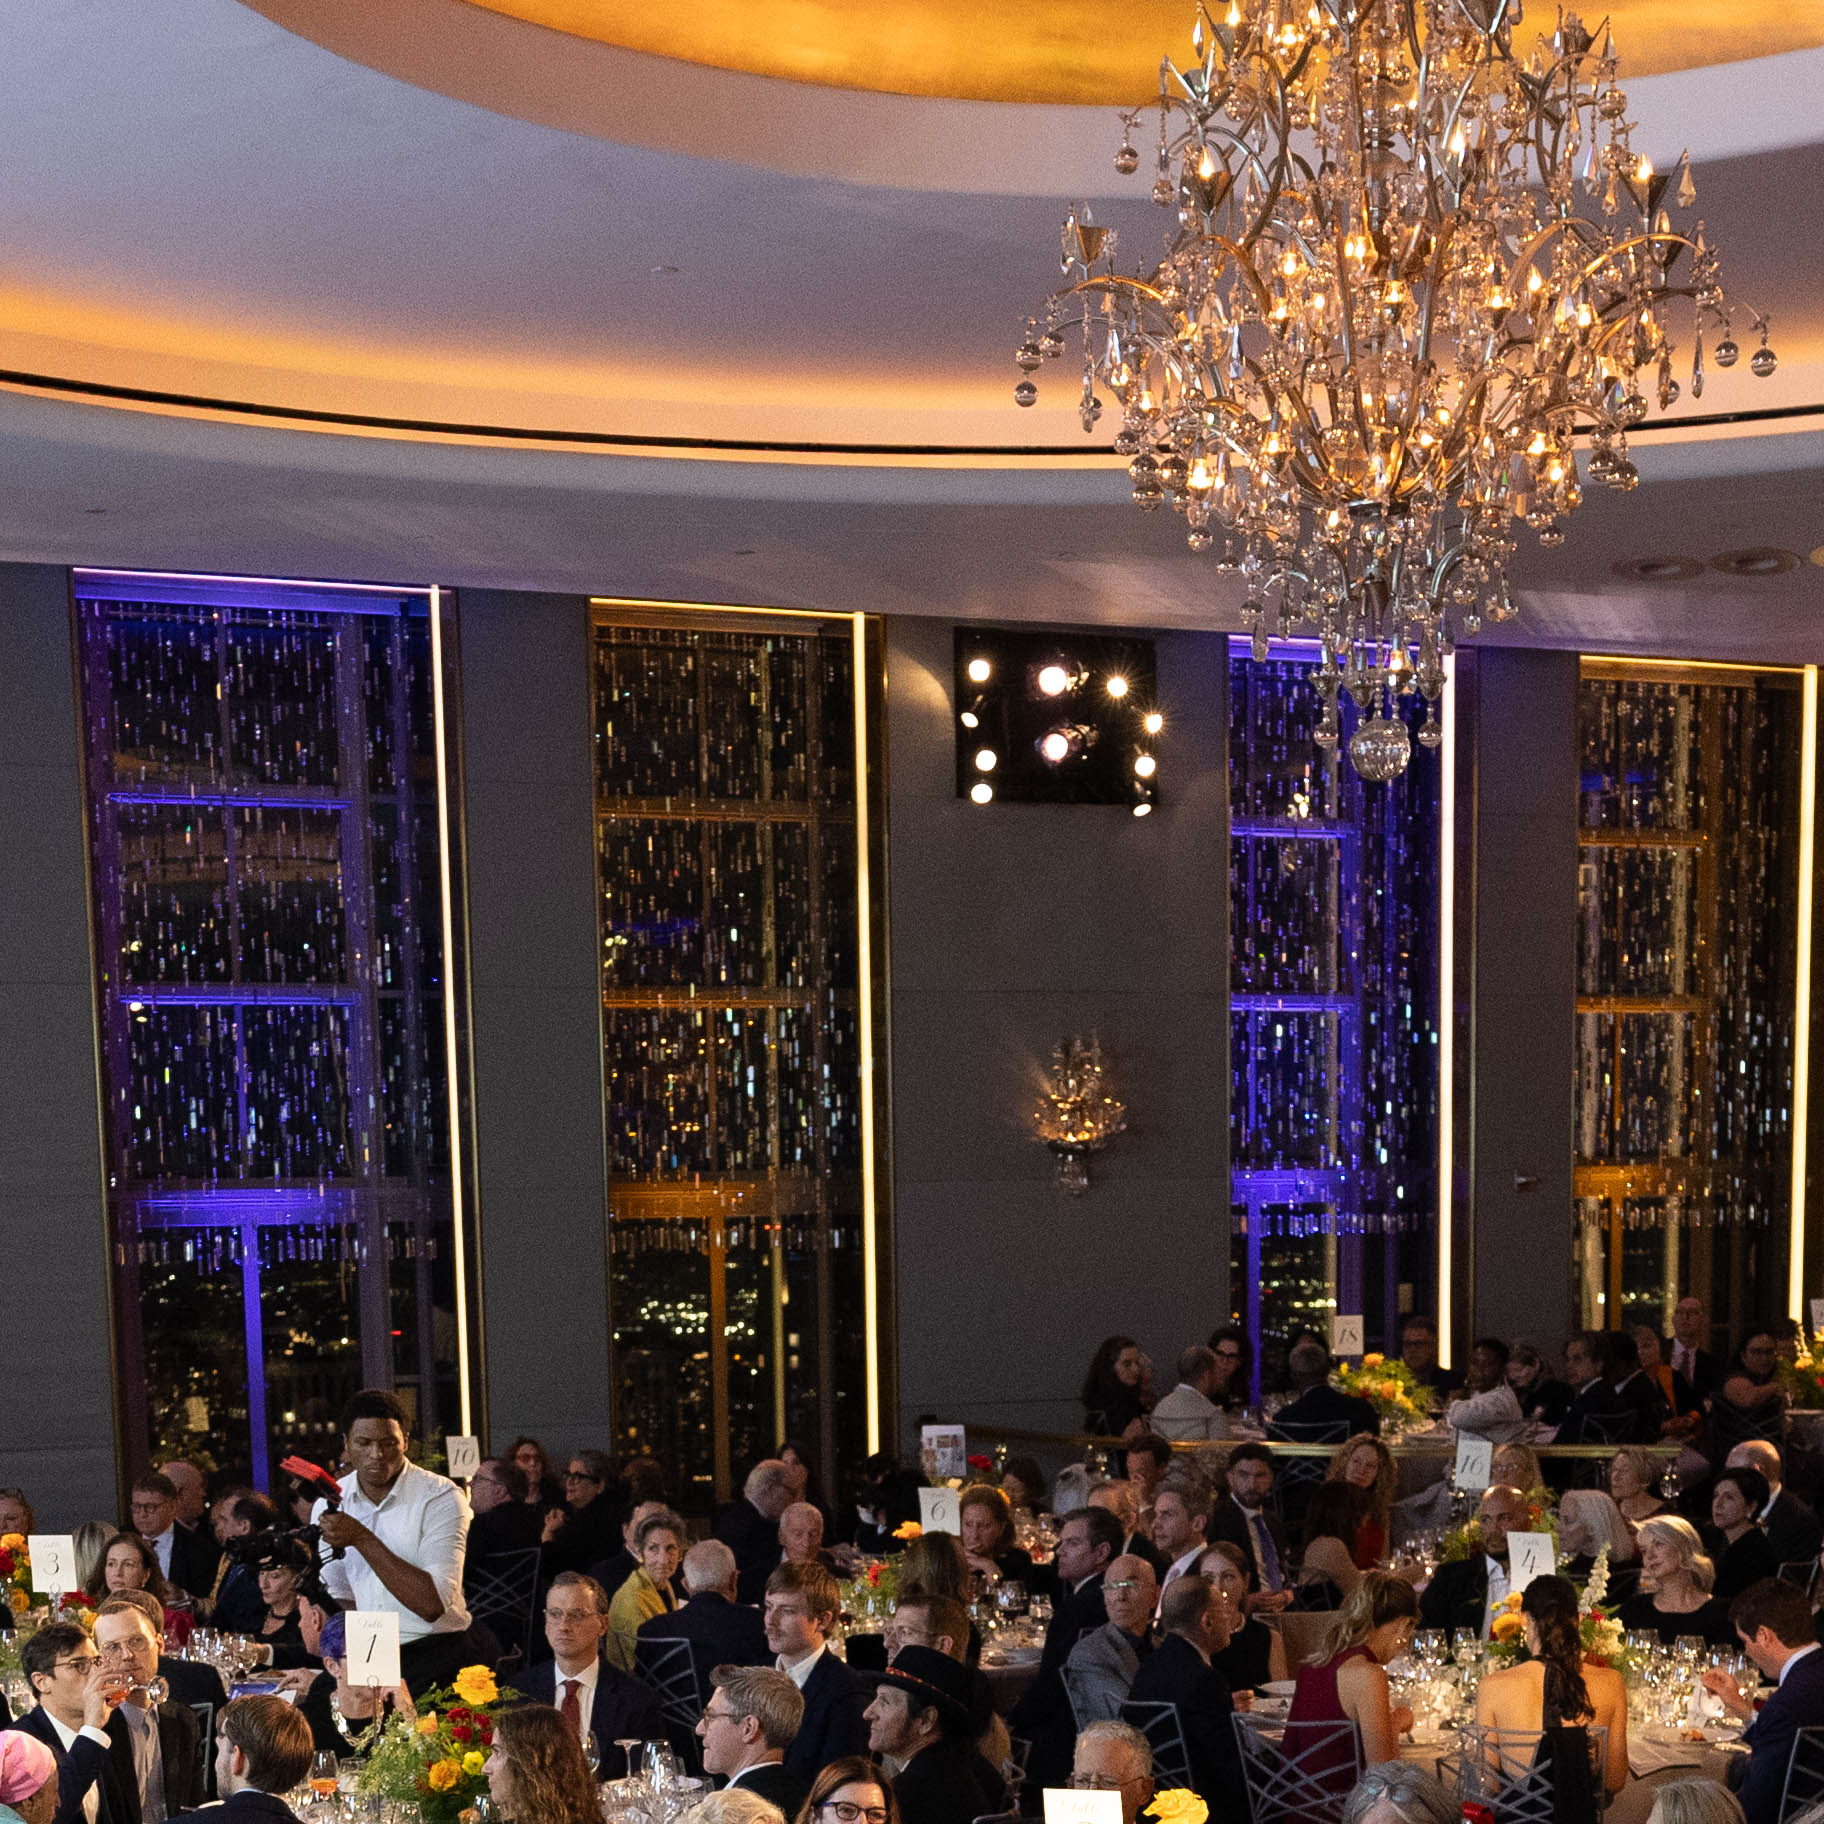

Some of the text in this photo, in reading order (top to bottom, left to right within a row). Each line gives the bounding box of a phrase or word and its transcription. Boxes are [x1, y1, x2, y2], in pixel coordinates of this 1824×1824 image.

[453, 1448, 476, 1466] 10
[1460, 1454, 1484, 1476] 16
[931, 1499, 946, 1522] 6
[43, 1552, 60, 1576] 3
[1520, 1548, 1542, 1575] 4
[366, 1633, 377, 1664] 1
